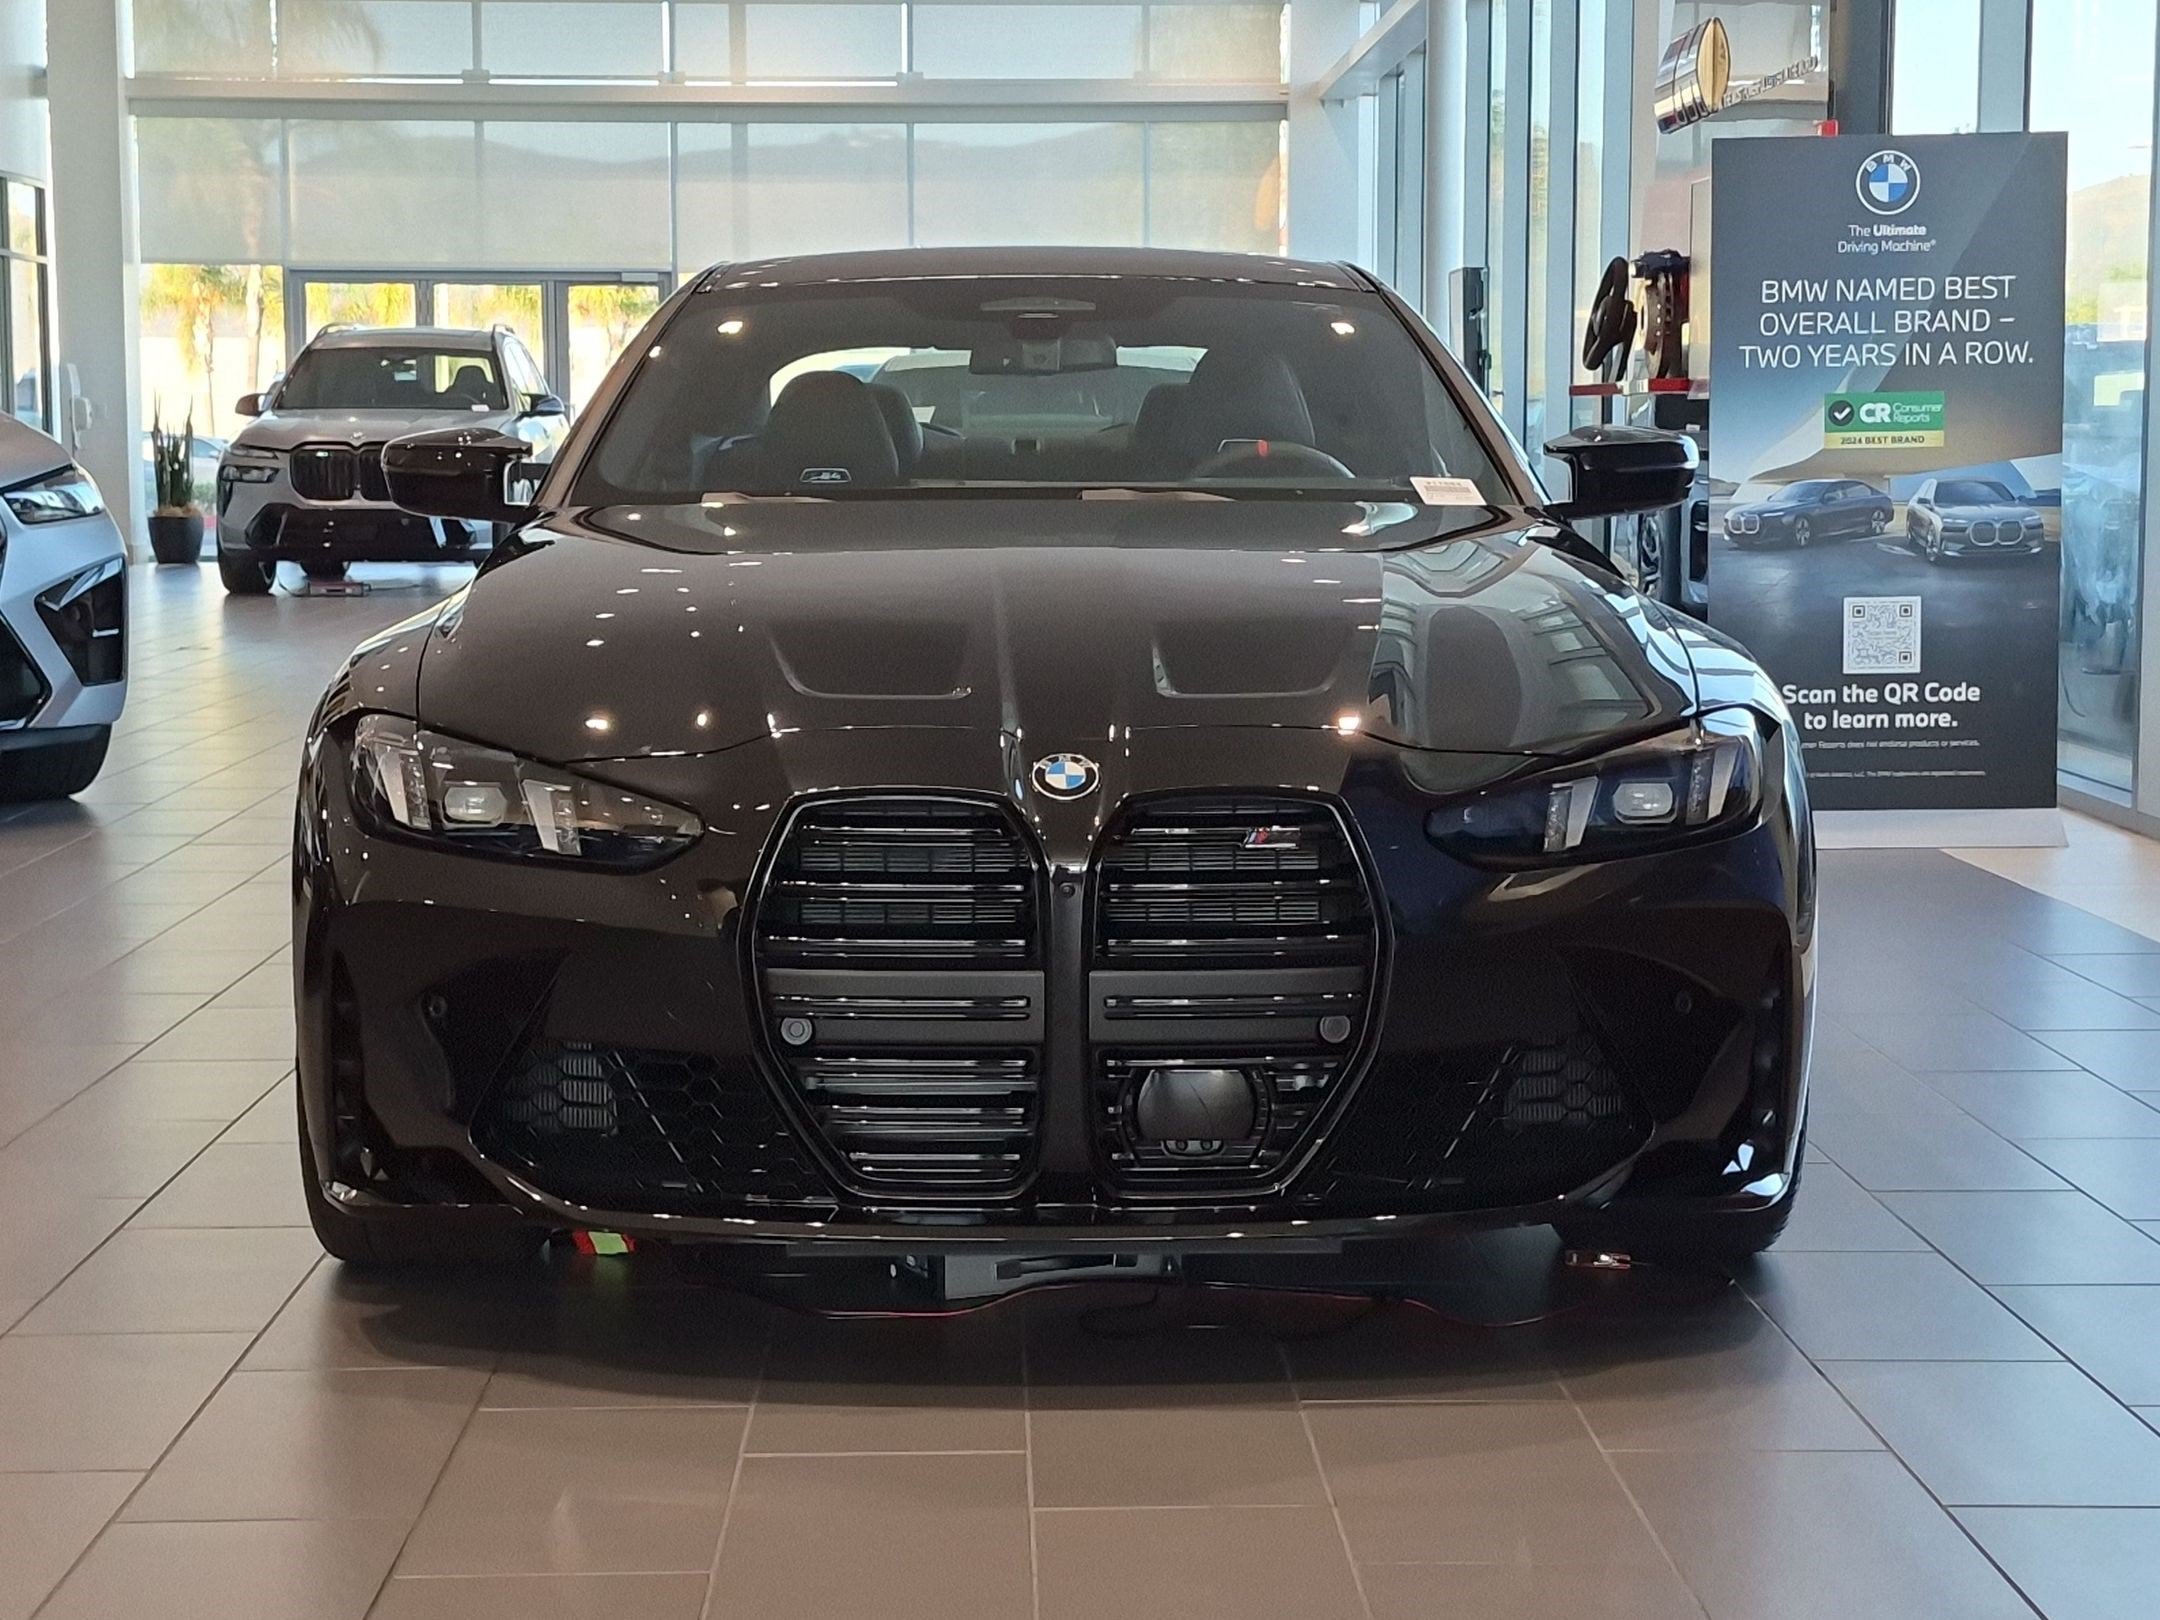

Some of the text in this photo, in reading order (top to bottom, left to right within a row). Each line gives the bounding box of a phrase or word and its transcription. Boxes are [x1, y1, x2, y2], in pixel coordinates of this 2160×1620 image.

[1865, 154, 1912, 173] BMW
[1848, 224, 1927, 237] The Ultimate
[1837, 241, 1879, 256] Driving
[1761, 275, 2017, 304] BMW NAMED BEST
[1760, 311, 1887, 336] OVERALL
[1894, 309, 1991, 334] BRAND
[1738, 340, 2034, 369] TWO YEARS IN A ROW.
[1859, 402, 1892, 423] CR
[1893, 402, 1943, 413] Consumer
[1893, 413, 1930, 424] Reports
[1865, 436, 1888, 445] BEST
[1891, 435, 1925, 444] BRAND
[1782, 681, 1981, 705] Scan the QR Code
[1804, 709, 1959, 730] to learn more.
